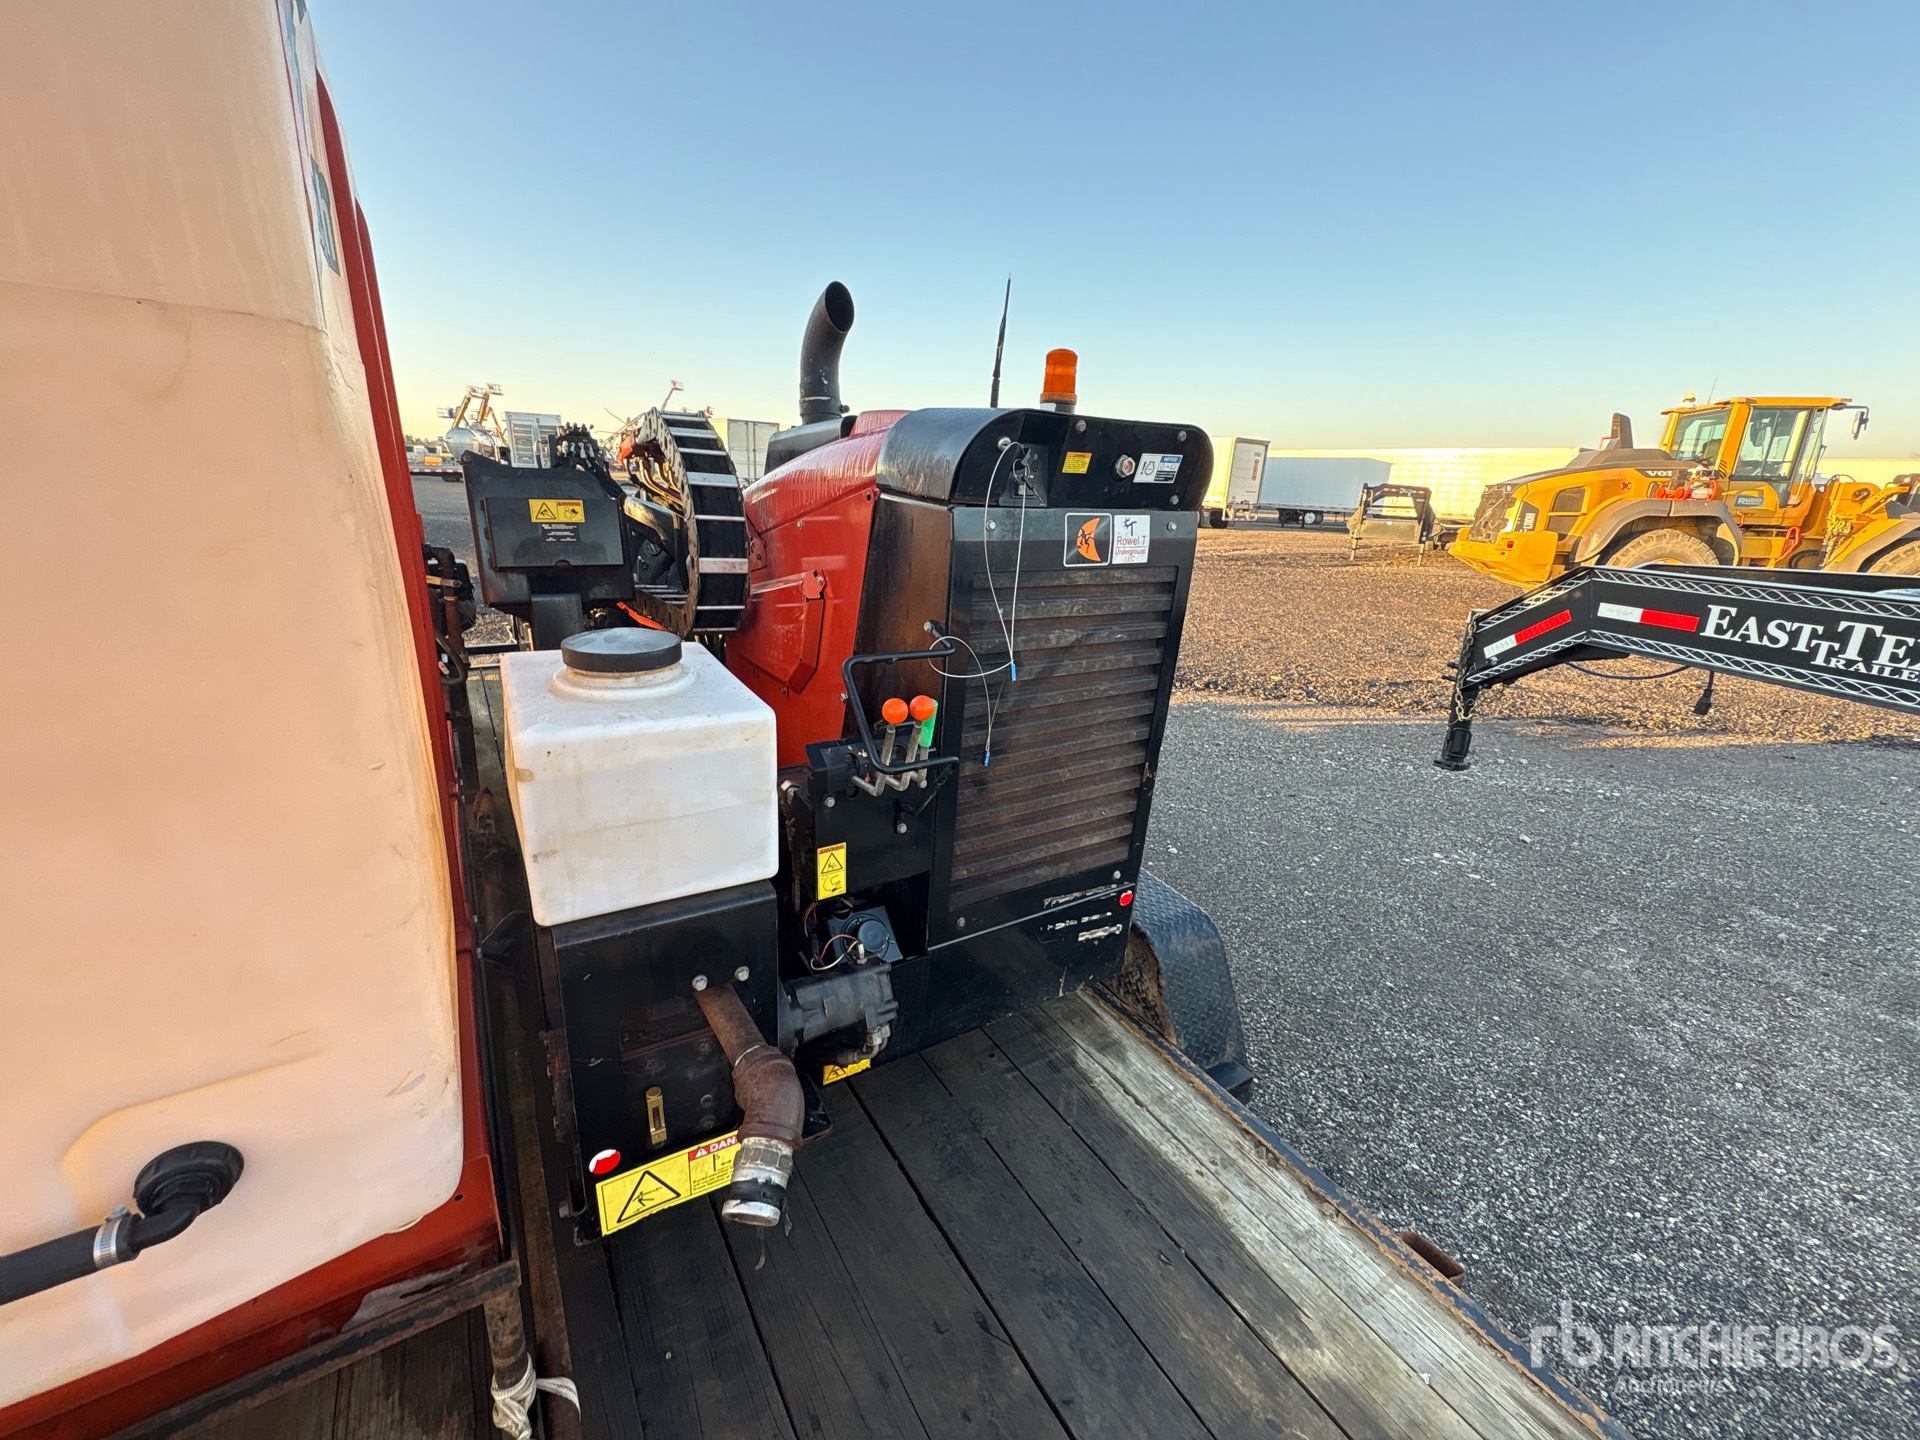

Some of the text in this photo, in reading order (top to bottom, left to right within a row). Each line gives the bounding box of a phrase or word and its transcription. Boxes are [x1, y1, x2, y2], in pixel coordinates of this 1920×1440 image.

[1700, 604, 1920, 670] EAST TE
[1810, 639, 1920, 683] TRAILE
[710, 1136, 738, 1152] DAN
